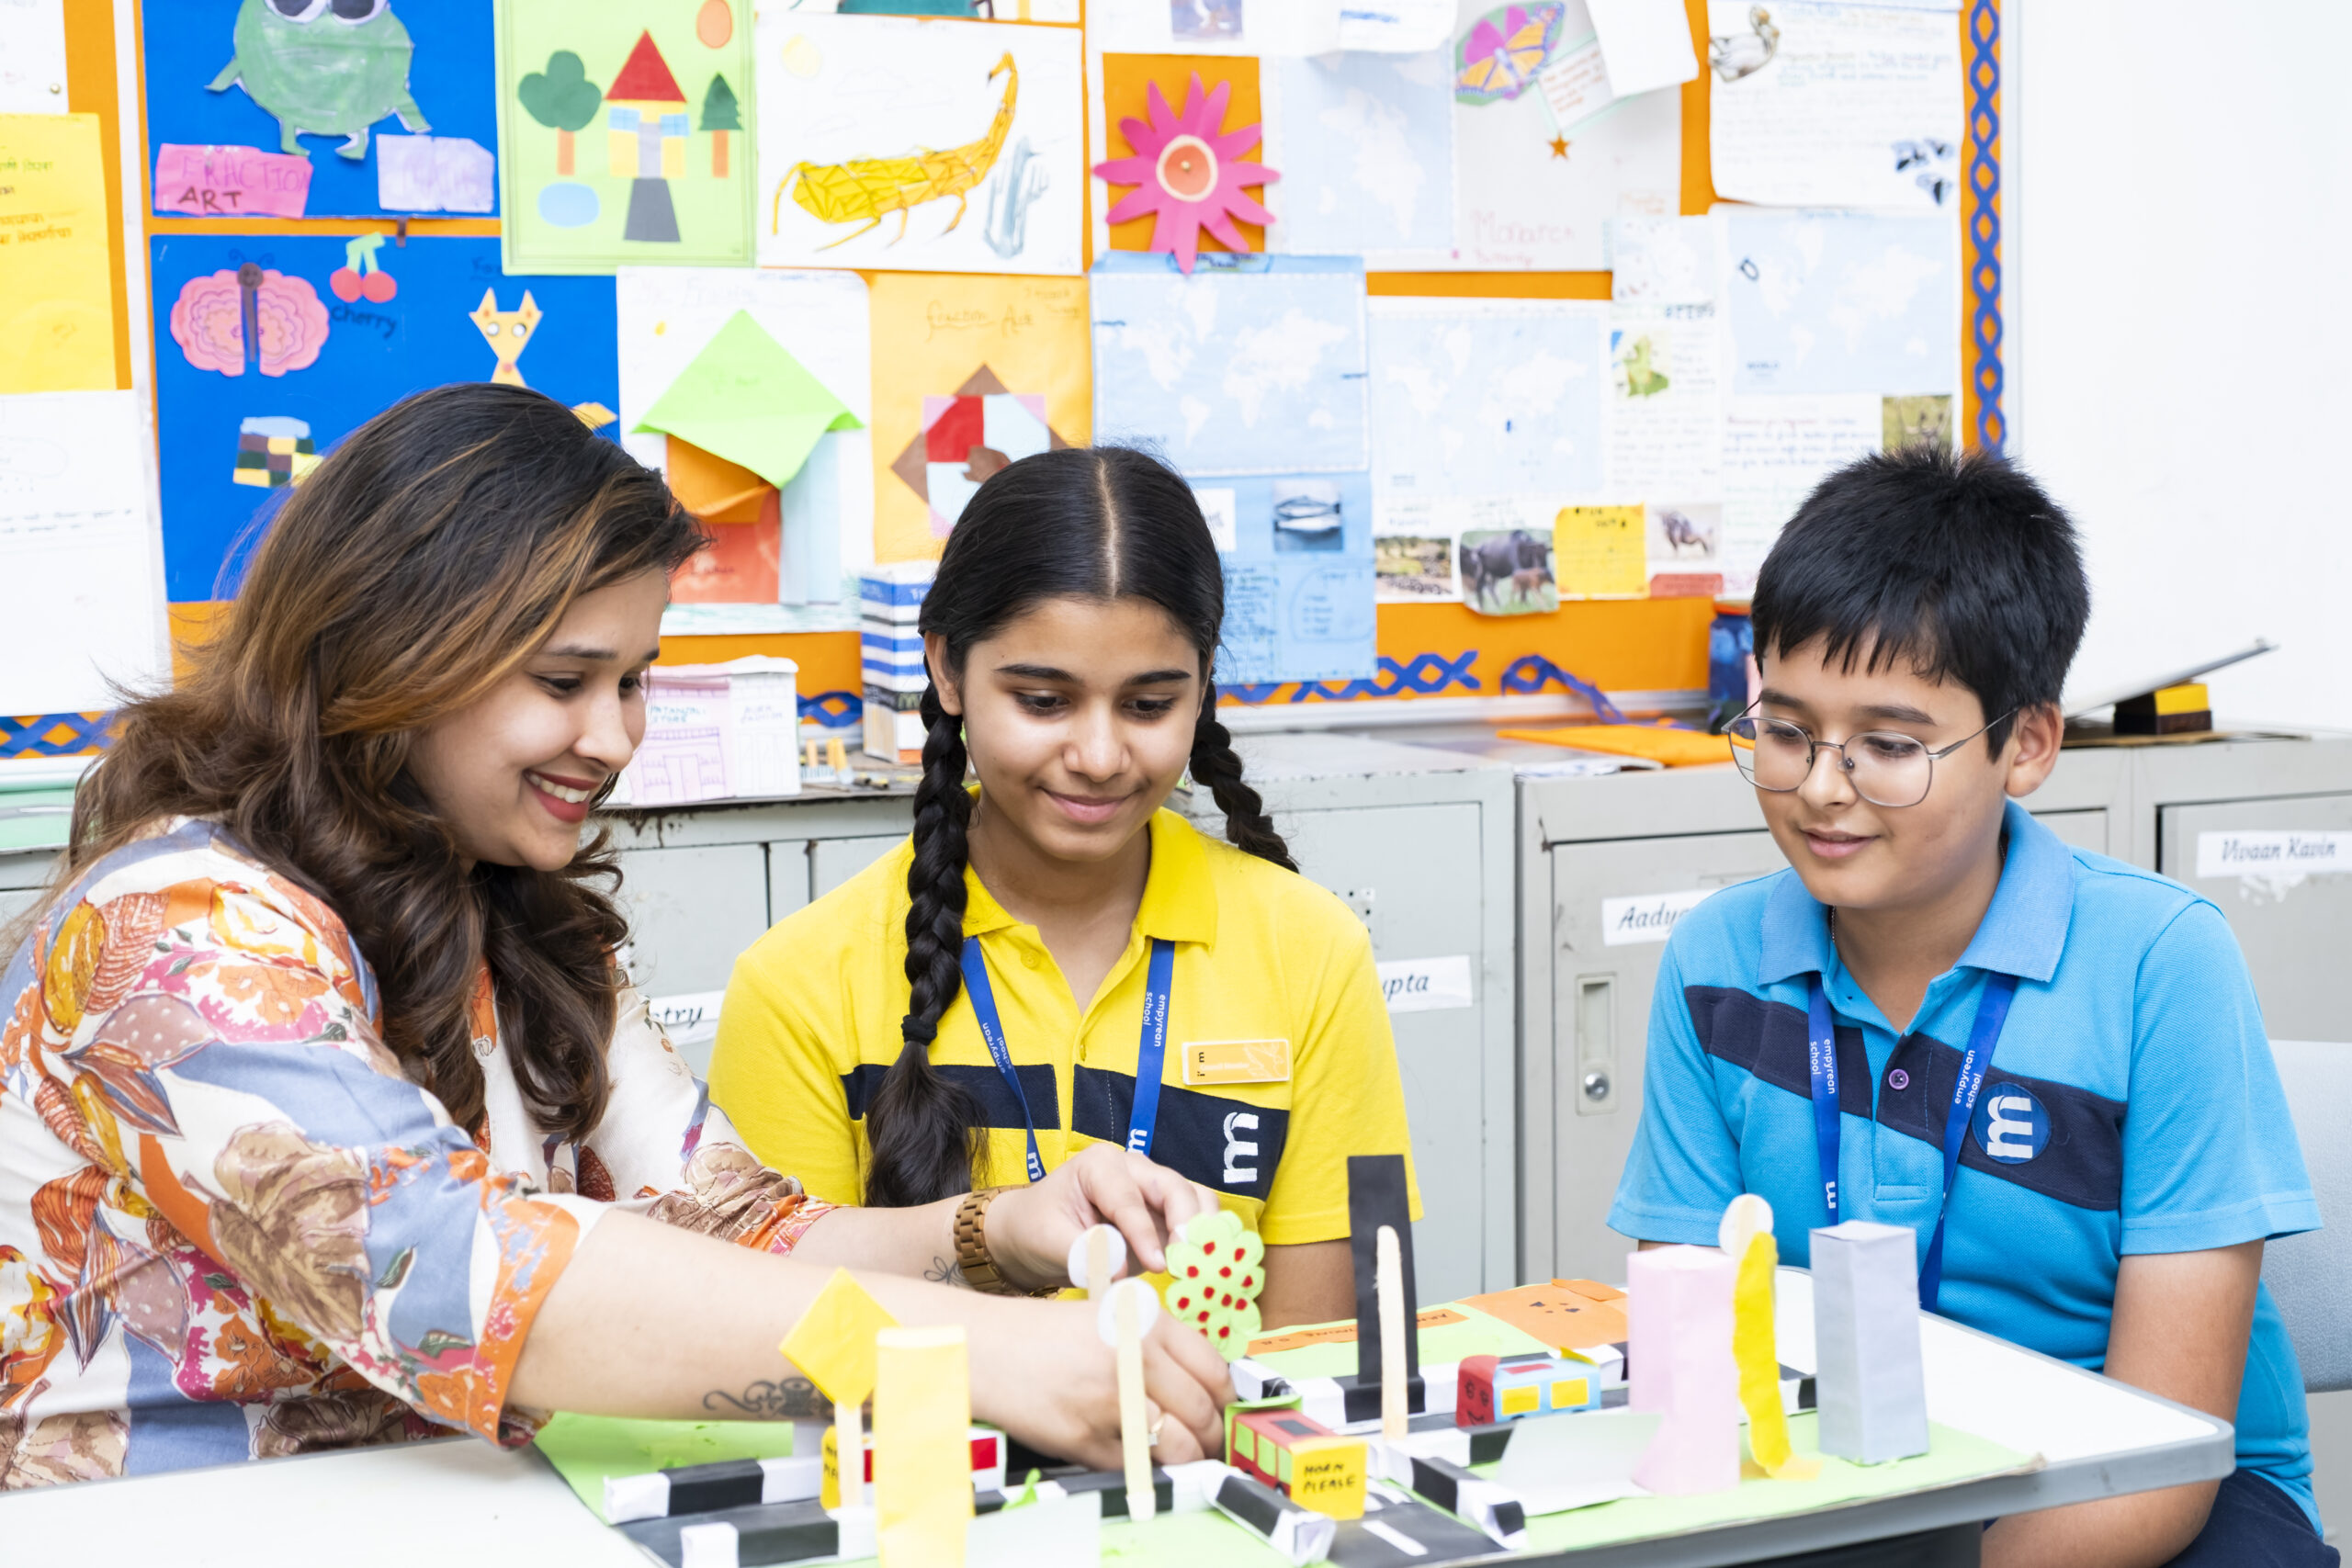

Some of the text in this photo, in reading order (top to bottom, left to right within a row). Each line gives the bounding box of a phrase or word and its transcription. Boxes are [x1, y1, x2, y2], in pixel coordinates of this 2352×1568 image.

[177, 186, 243, 212] ART
[2222, 835, 2336, 862] Vivaan Kavin
[1142, 990, 1153, 1026] school
[1154, 993, 1167, 1047] empyrean
[982, 1022, 1006, 1074] empyrean
[997, 1036, 1012, 1070] school
[1809, 1041, 1822, 1075] school
[1823, 1038, 1836, 1094] empyrean
[1954, 1049, 1976, 1104] empyrean
[1965, 1073, 1983, 1109] school
[1986, 1094, 2034, 1159] m
[1222, 1111, 1260, 1184] m
[1304, 1474, 1356, 1492] PLEASE
[1305, 1462, 1344, 1474] HORN
